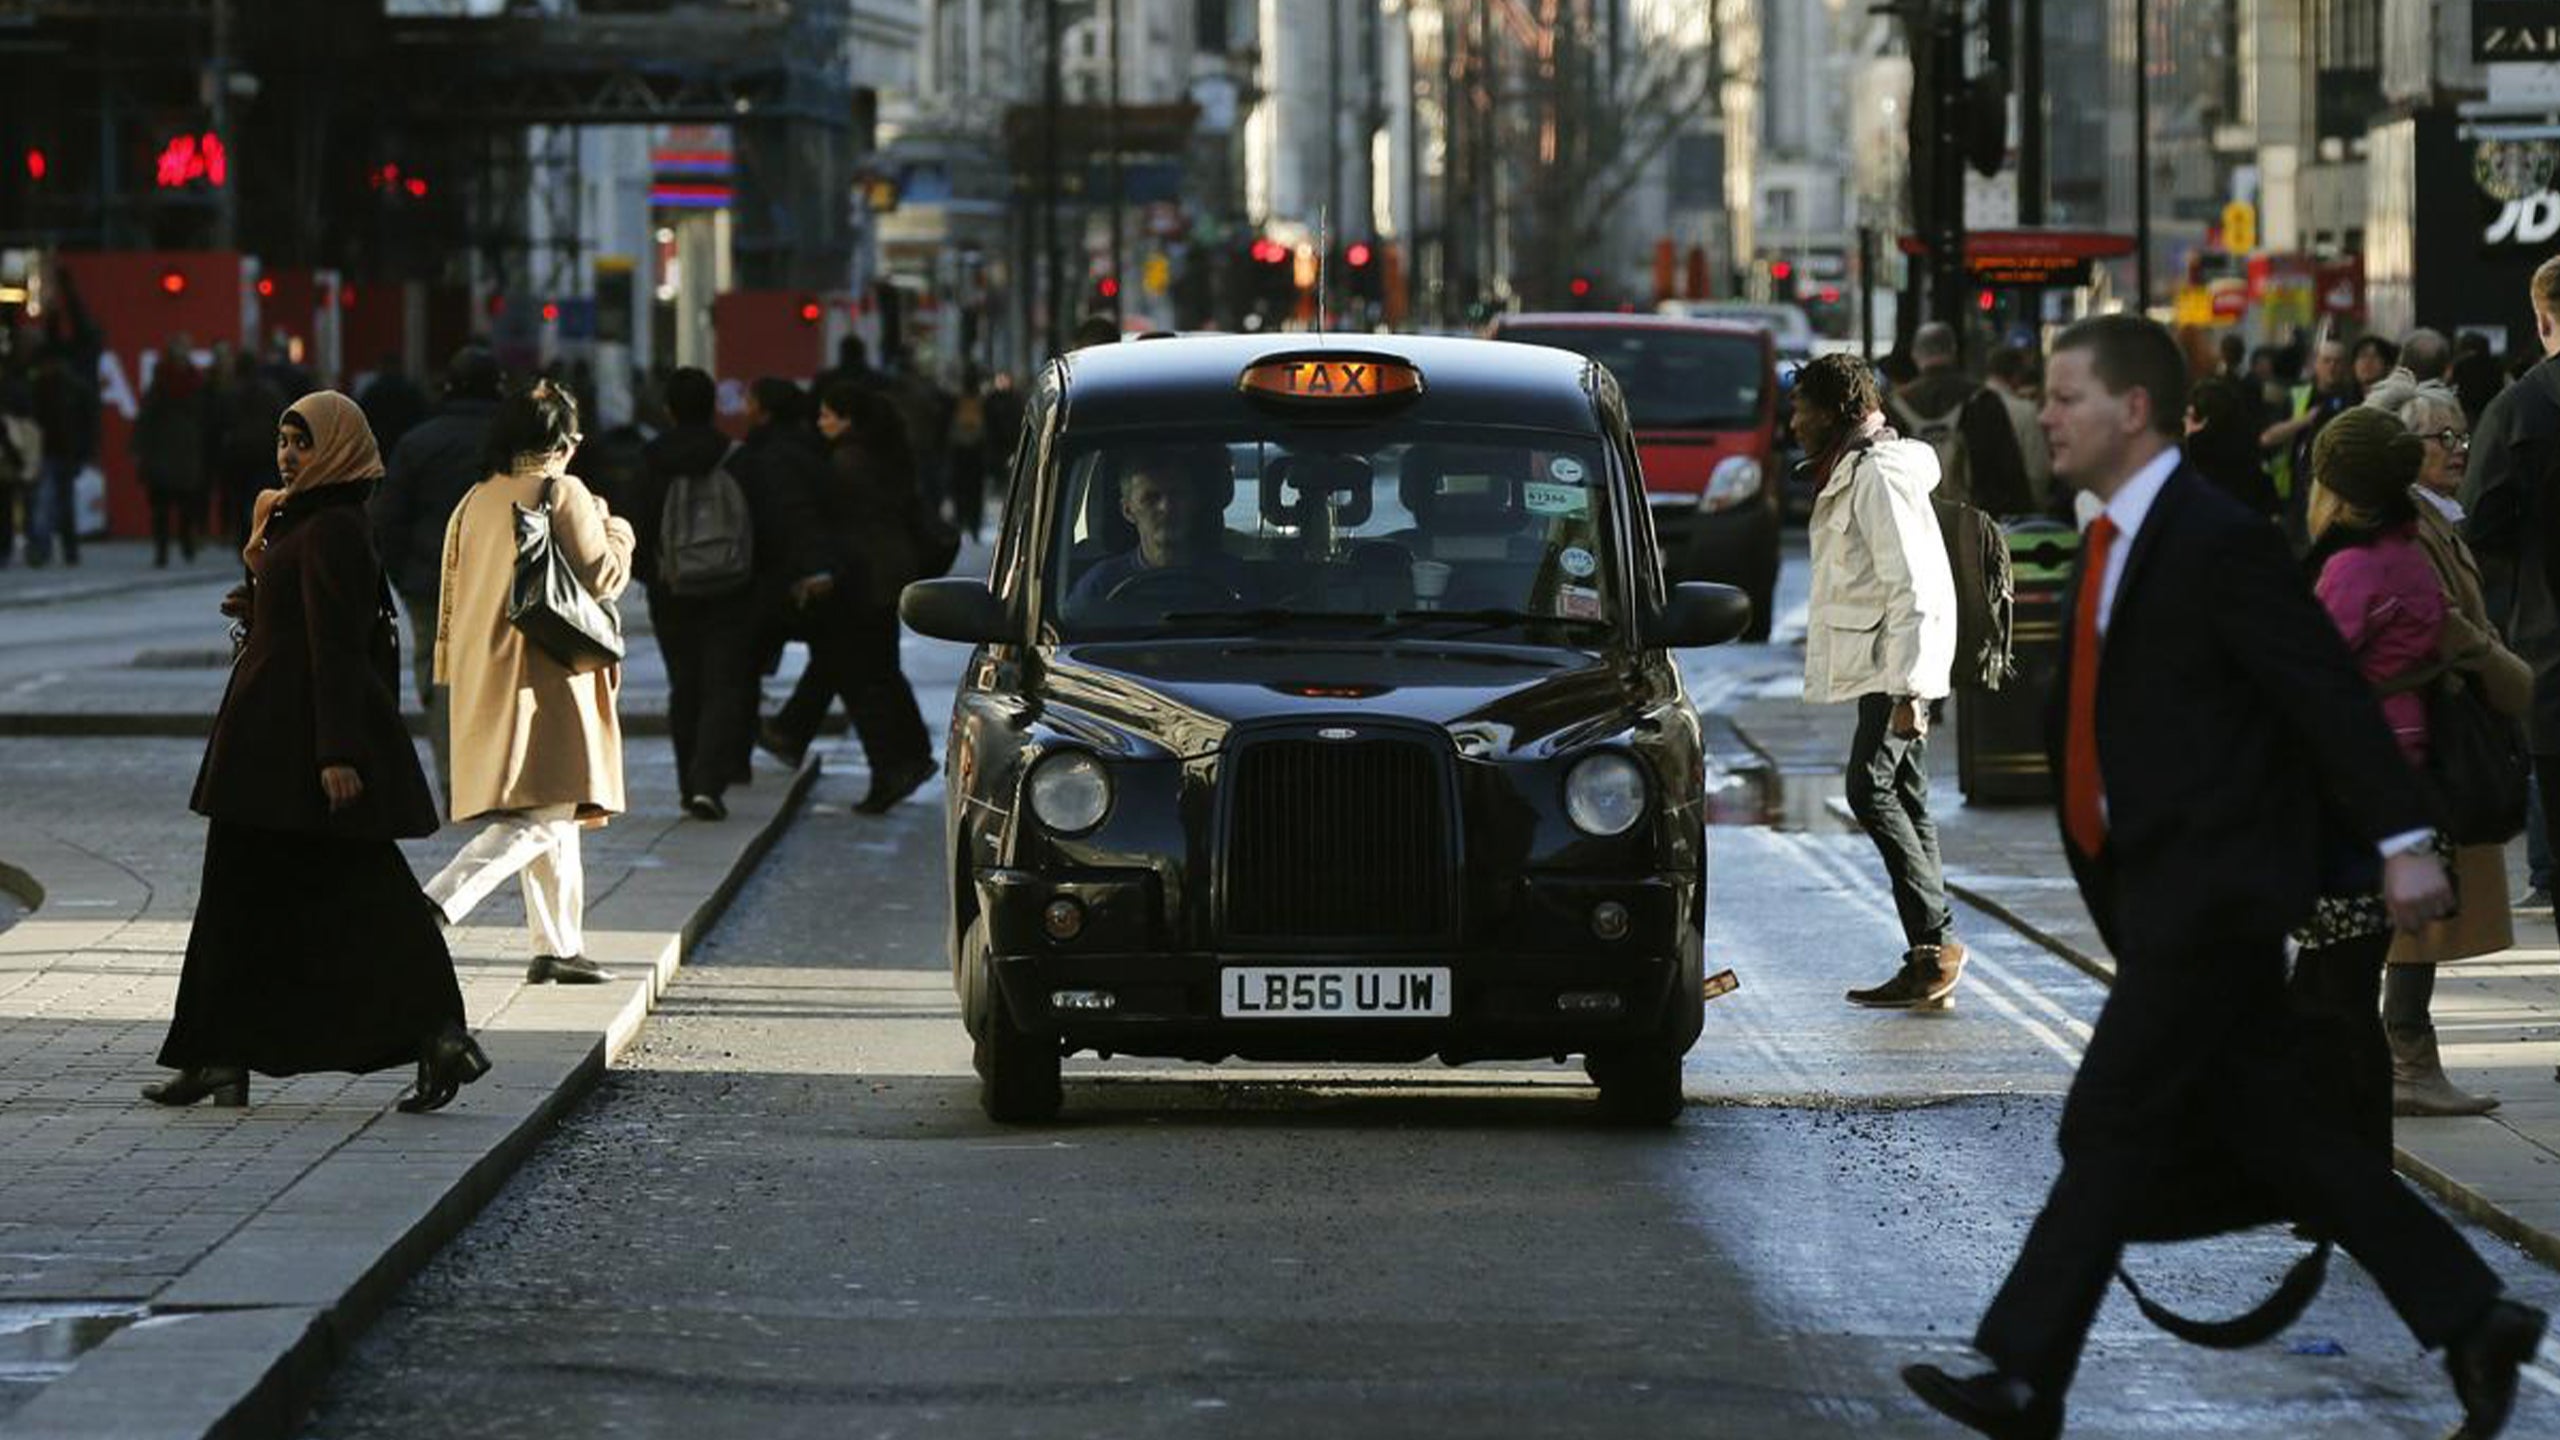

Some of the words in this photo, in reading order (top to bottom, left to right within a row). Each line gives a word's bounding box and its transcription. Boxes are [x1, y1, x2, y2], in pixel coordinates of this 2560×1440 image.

[2484, 189, 2560, 244] JD
[1282, 364, 1384, 393] TAXI
[1237, 973, 1343, 1012] LB56
[1355, 973, 1434, 1012] UJW
